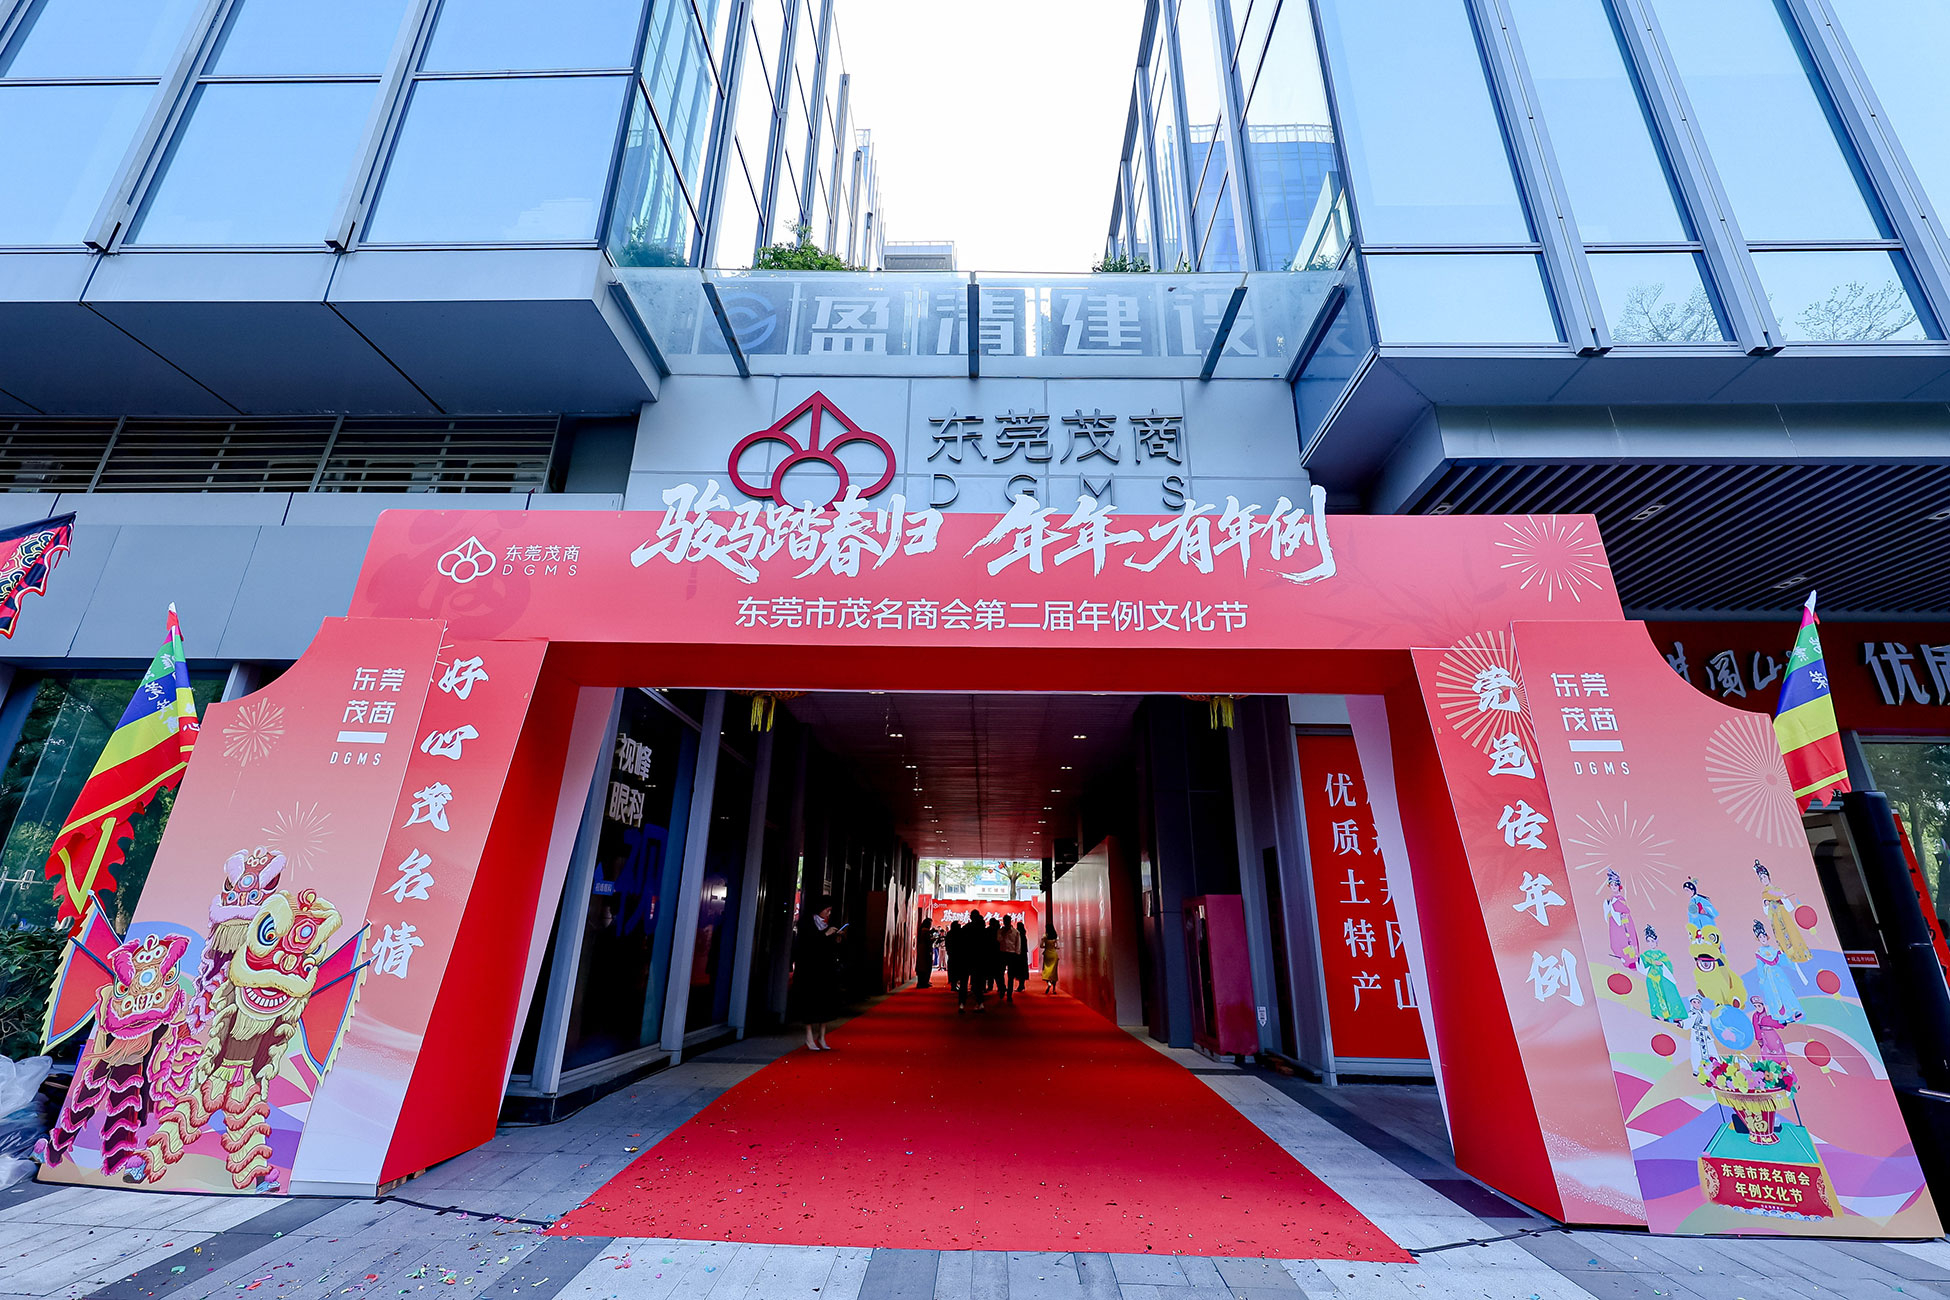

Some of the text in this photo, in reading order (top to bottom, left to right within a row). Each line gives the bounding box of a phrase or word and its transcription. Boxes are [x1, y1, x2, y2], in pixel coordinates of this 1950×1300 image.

[809, 293, 1258, 356] 盈清建设
[927, 406, 1186, 465] 东莞茂商
[929, 473, 1188, 511] DGMS
[630, 480, 943, 584] 骏马踏春归
[964, 484, 1338, 585] 年年有年例
[504, 544, 581, 563] 东莞茂商
[502, 564, 578, 577] DGMS
[735, 596, 1250, 633] 东莞市茂名商会第二届年例文化节
[352, 666, 406, 692] 东莞
[1550, 672, 1610, 698] 东莞
[342, 699, 397, 725] 茂商
[1561, 706, 1619, 732] 茂商
[329, 751, 383, 767] DGMS
[615, 733, 652, 781] 视峰
[1573, 761, 1631, 776] DGMS
[371, 655, 490, 980] 好心茂名情
[608, 781, 645, 828] 眼科
[1470, 663, 1586, 1008] 莞邑传年例
[1324, 772, 1383, 1013] 优质土特产
[1720, 1163, 1811, 1187] 东莞市茂名商会
[1735, 1181, 1804, 1204] 年例文化节
